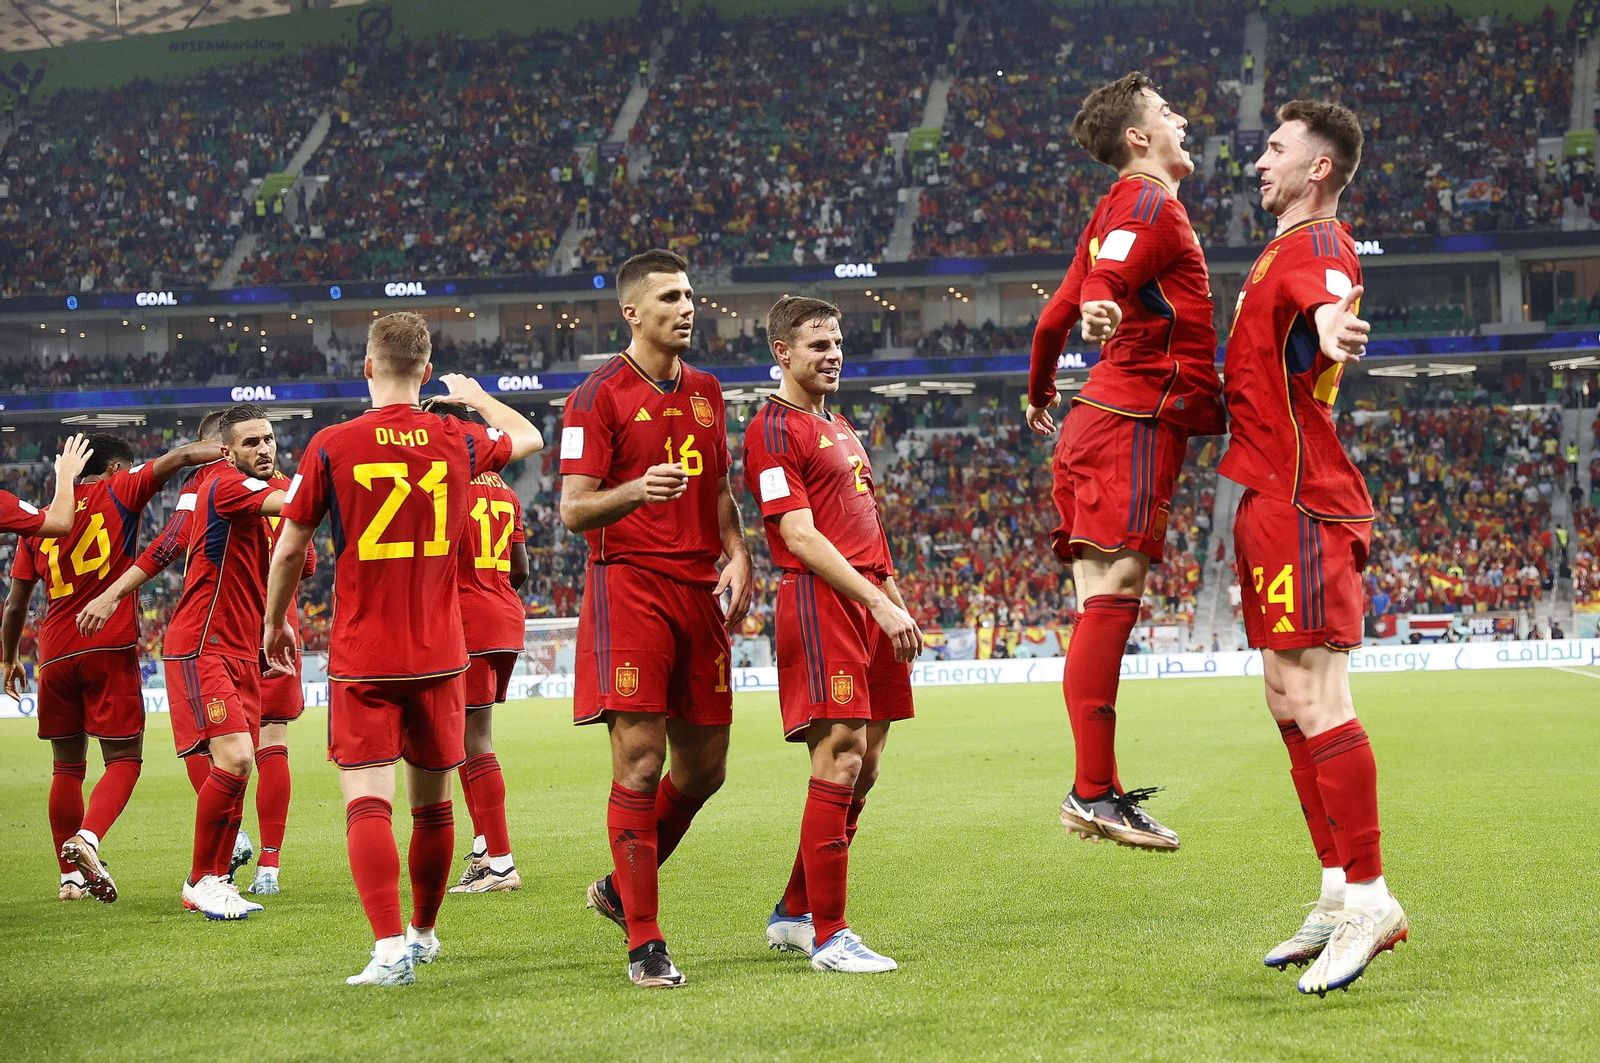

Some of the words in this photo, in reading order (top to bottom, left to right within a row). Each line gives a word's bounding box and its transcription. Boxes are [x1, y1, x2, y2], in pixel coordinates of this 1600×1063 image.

[168, 39, 285, 52] #FIFAWorldCup
[1354, 240, 1384, 255] OAL
[834, 263, 877, 278] GOAL
[385, 281, 427, 297] GOAL
[136, 291, 178, 307] GOAL
[1057, 354, 1087, 369] OAL
[497, 374, 543, 391] GOAL
[230, 385, 276, 401] GOAL
[375, 427, 429, 447] OLMO
[664, 434, 704, 476] 16
[847, 454, 868, 492] 2
[353, 461, 451, 561] 21
[470, 497, 515, 572] 12
[39, 512, 111, 600] 14
[1157, 654, 1217, 678] قطر
[1350, 650, 1430, 671] Energy
[714, 651, 728, 692] 1
[913, 665, 1002, 684] rEnergy
